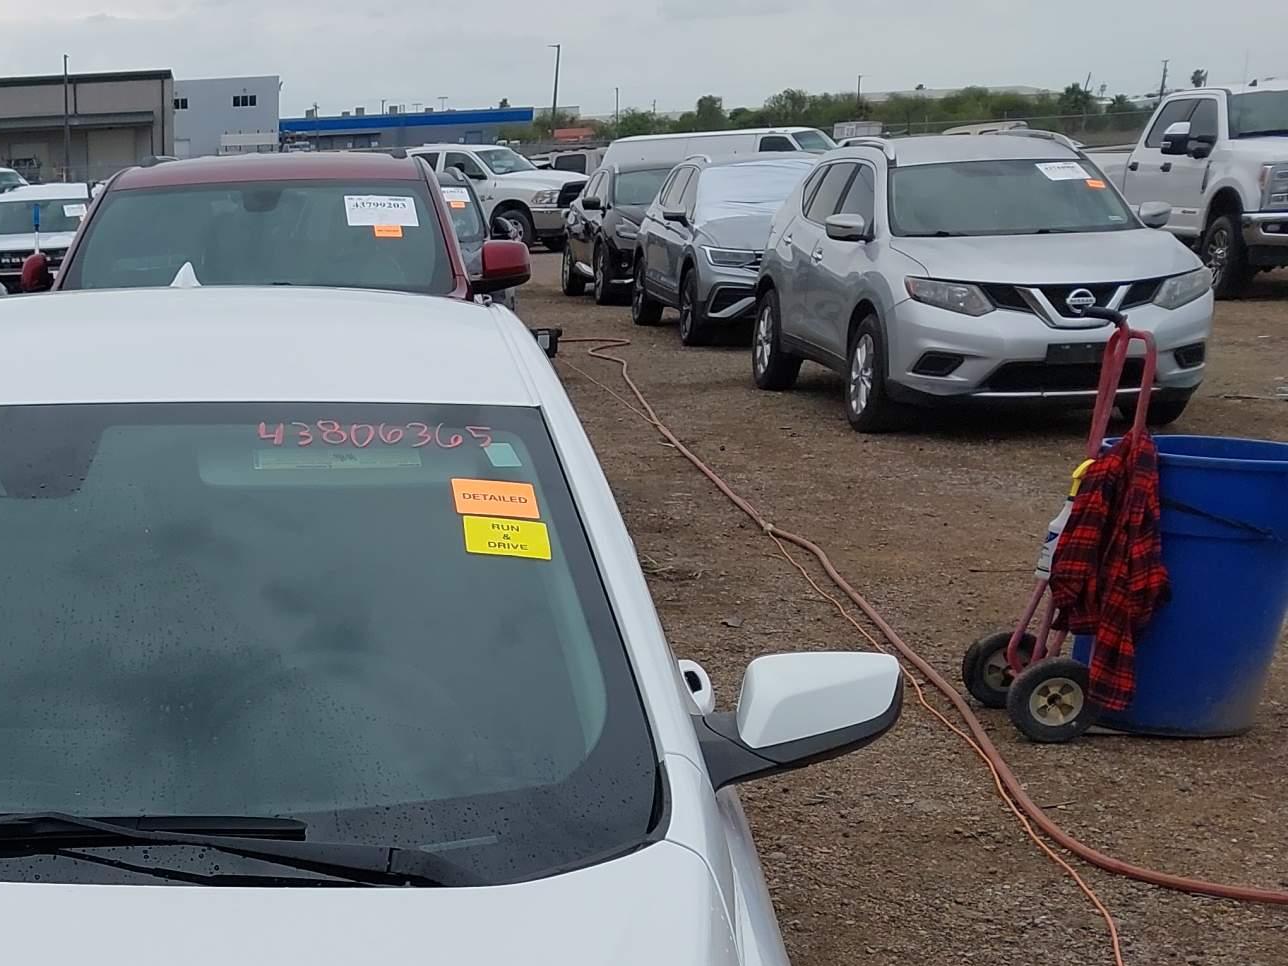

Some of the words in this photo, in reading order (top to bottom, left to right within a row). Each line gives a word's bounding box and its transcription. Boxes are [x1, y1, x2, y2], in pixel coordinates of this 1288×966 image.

[257, 419, 493, 448] 43806365
[462, 492, 528, 504] DETAILED
[491, 523, 520, 532] RUN
[488, 541, 529, 551] DRIVE
